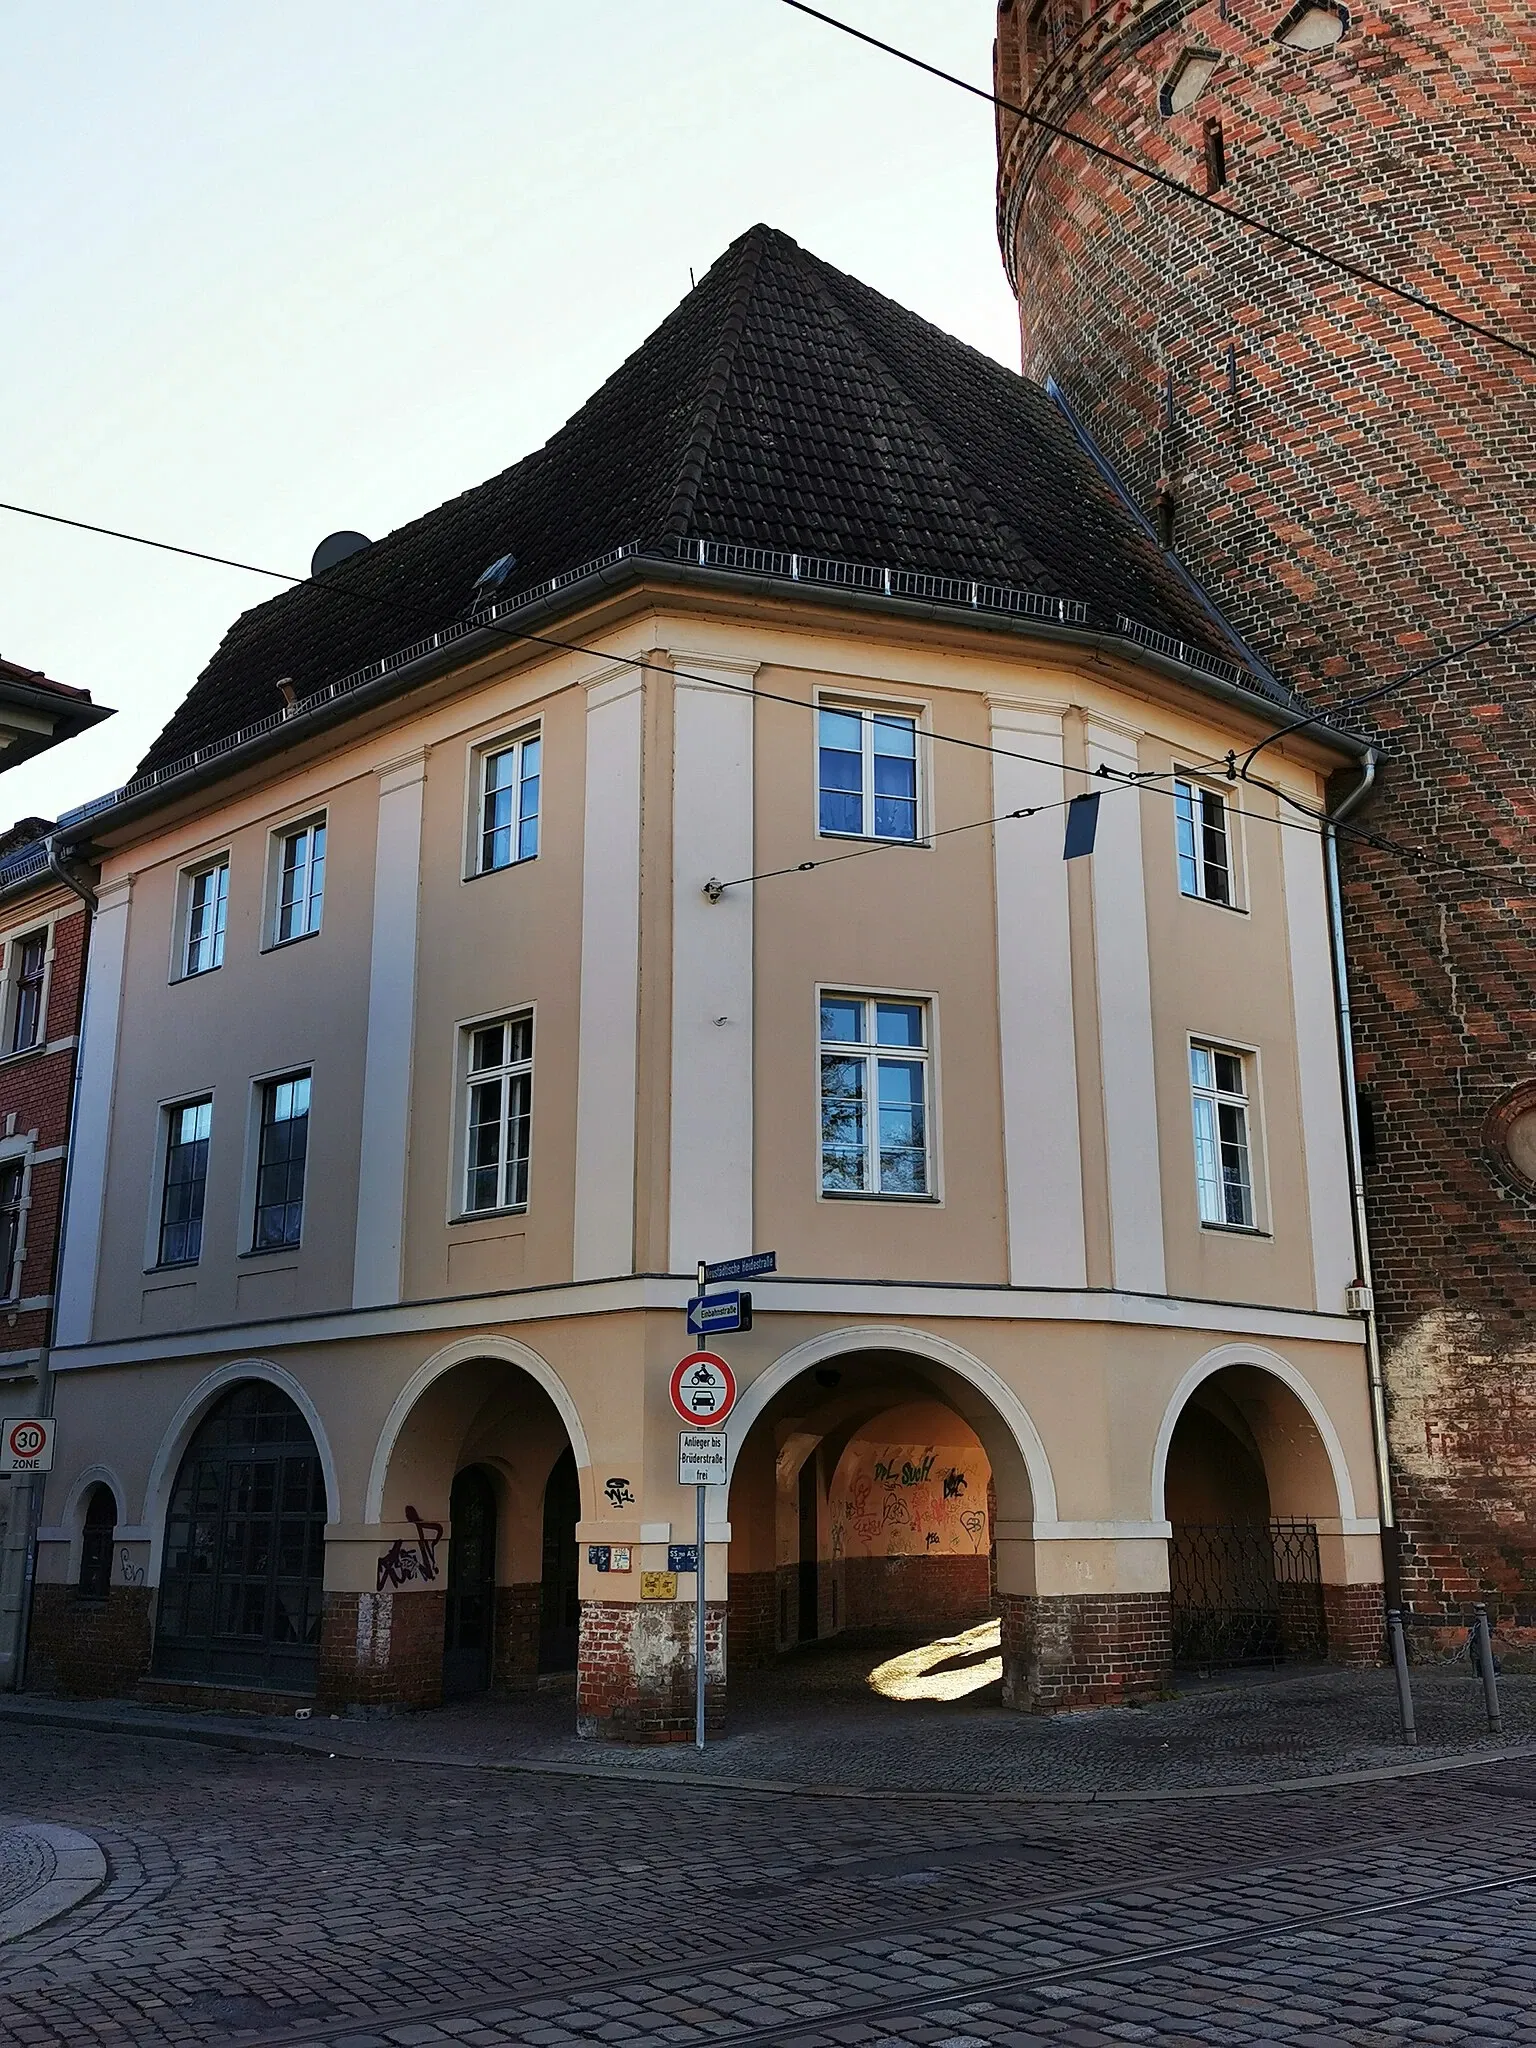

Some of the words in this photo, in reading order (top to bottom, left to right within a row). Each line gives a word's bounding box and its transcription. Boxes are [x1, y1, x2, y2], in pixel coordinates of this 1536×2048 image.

[701, 1305, 737, 1319] Einbahnstraße
[17, 1431, 39, 1448] 30
[684, 1436, 710, 1449] Anlieger
[712, 1437, 721, 1447] bis
[12, 1459, 40, 1469] ZONE
[682, 1453, 723, 1463] Brüderstraße
[696, 1469, 708, 1480] frei
